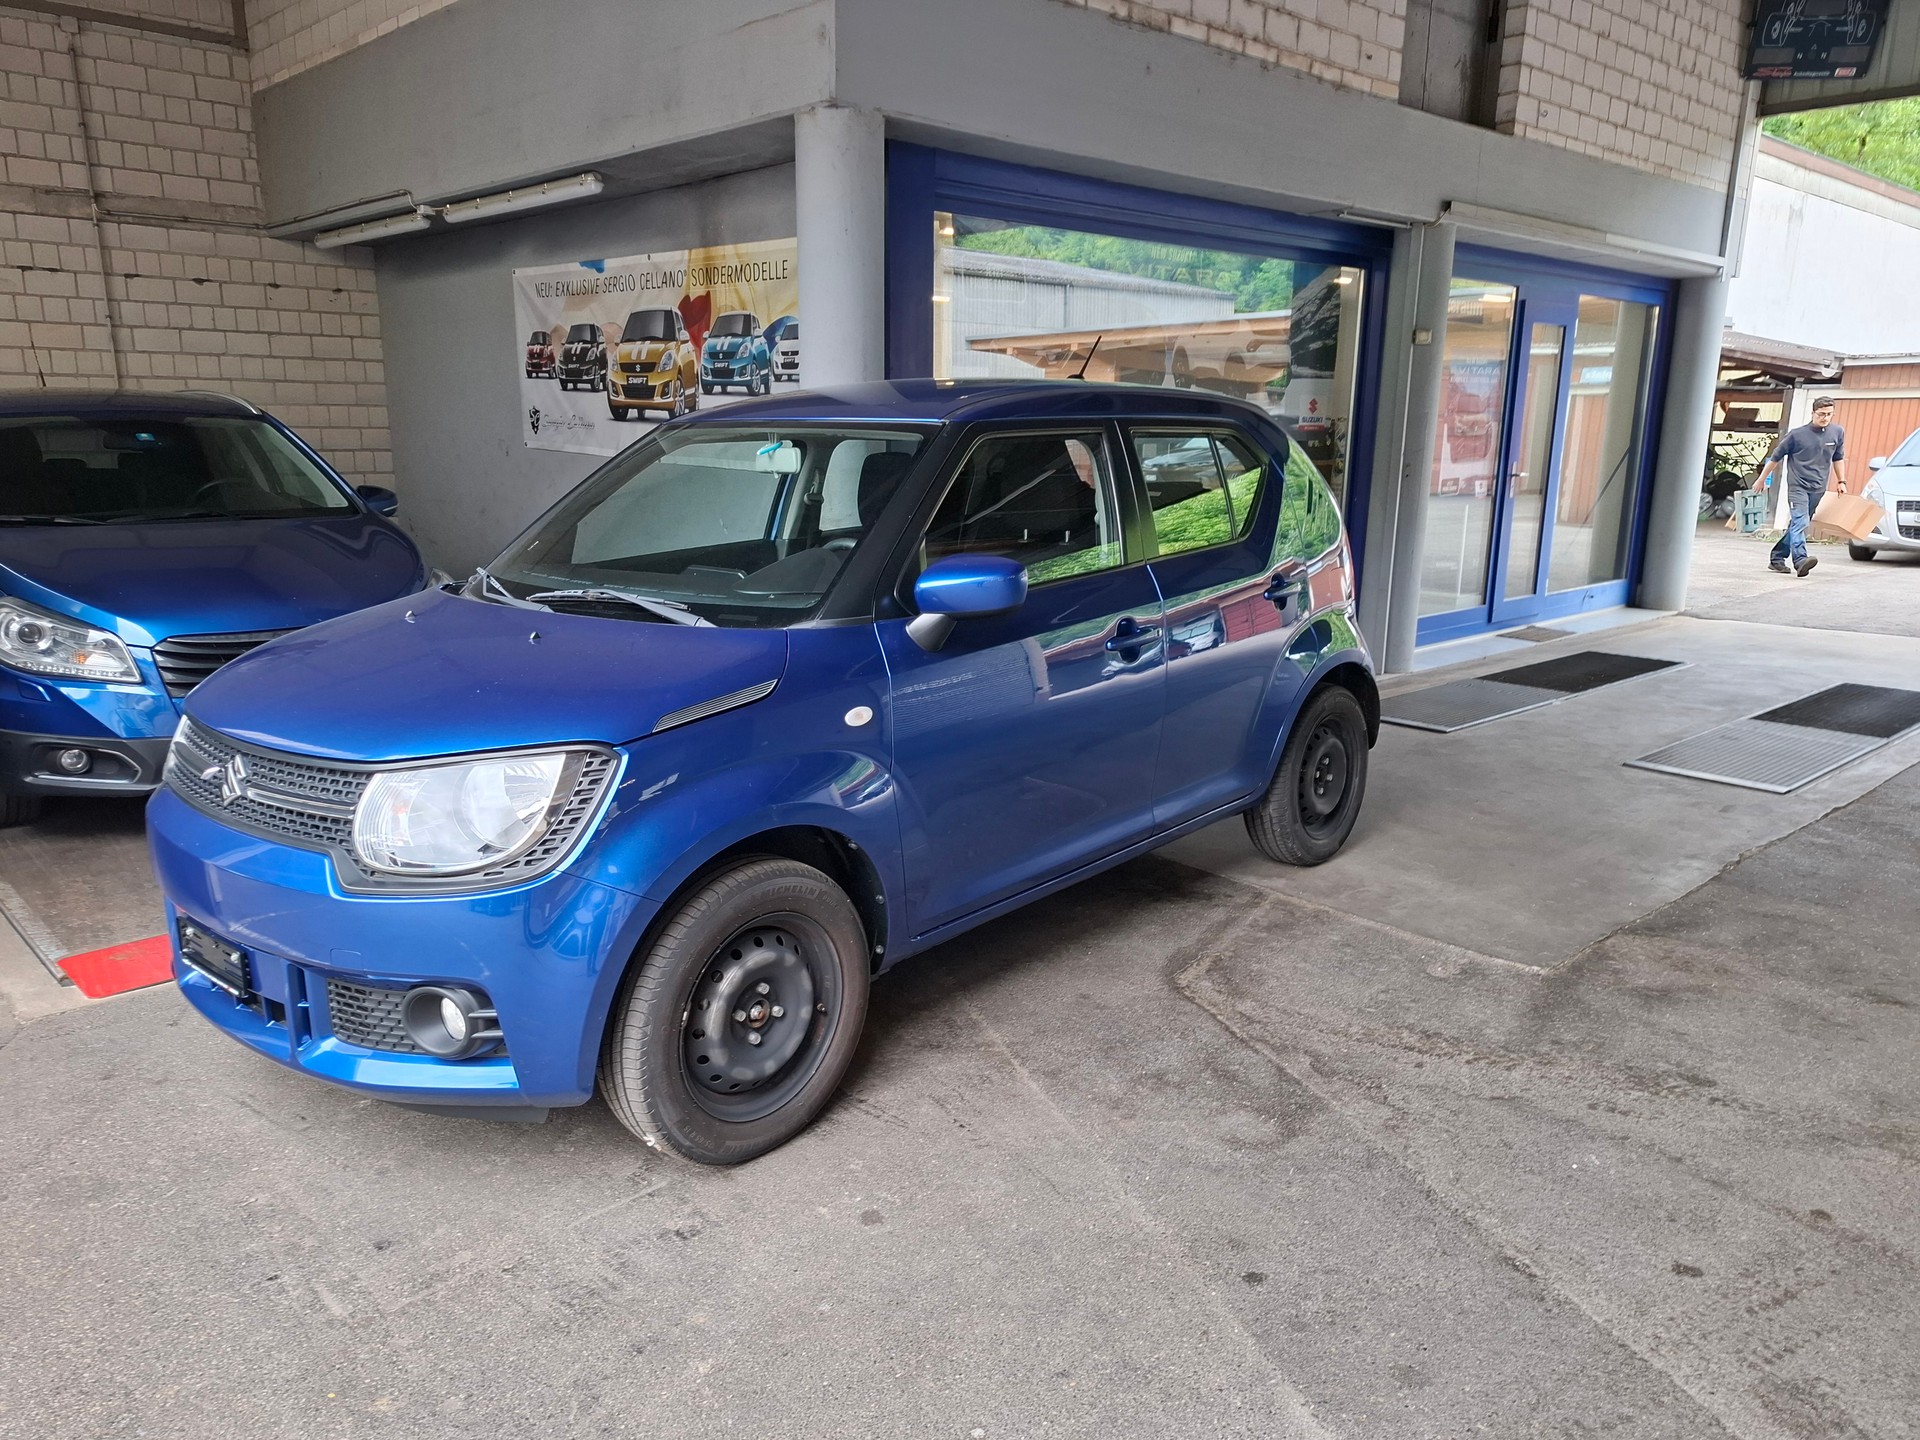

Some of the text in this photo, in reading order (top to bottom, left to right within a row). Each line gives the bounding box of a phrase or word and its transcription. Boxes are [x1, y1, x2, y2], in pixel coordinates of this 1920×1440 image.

[534, 281, 553, 298] NEU:
[555, 278, 601, 297] EXKLUSIVE
[602, 273, 636, 294] SERGIO
[691, 259, 789, 287] SONDERMODELLE
[628, 377, 648, 385] SWIFT
